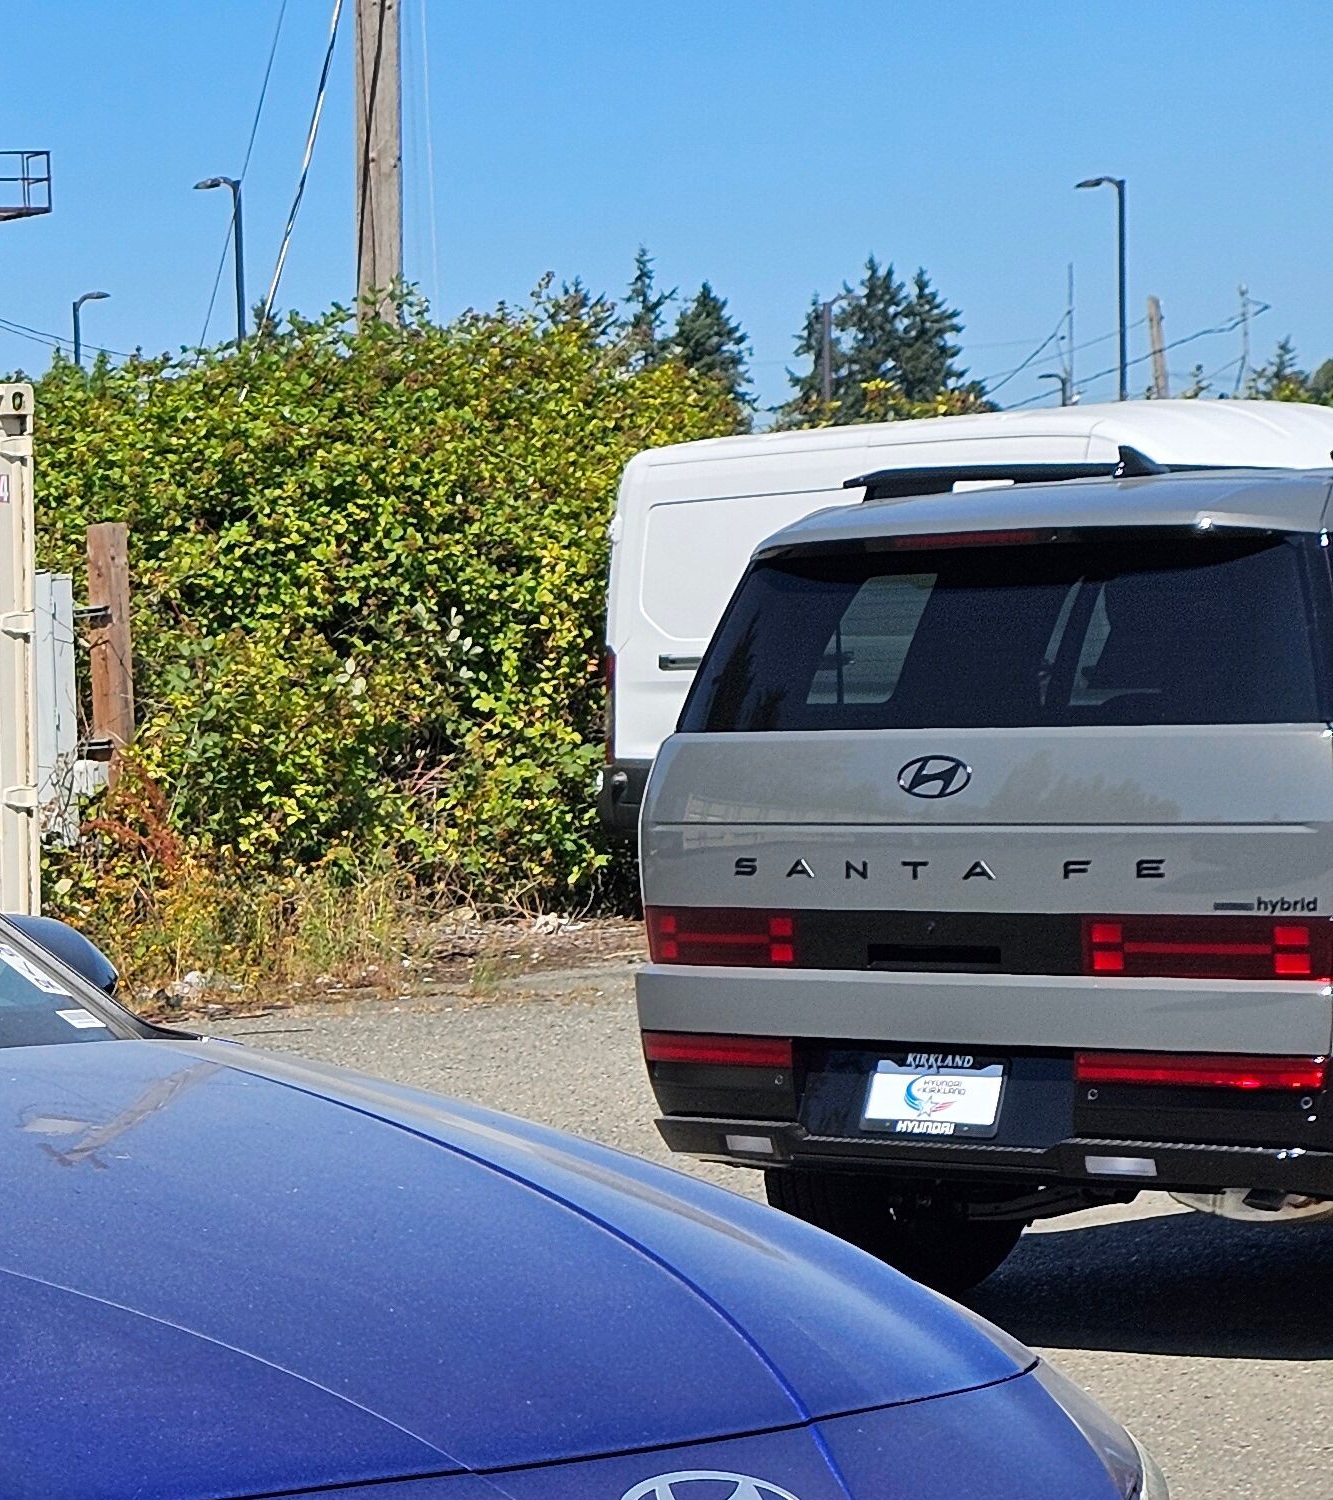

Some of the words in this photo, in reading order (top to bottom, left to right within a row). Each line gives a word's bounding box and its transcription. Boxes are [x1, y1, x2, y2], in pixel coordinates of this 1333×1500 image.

[734, 857, 996, 881] SANTA
[1062, 858, 1167, 881] FE
[1256, 896, 1318, 915] hybrid
[905, 1052, 974, 1074] KIRKLAND
[895, 1120, 956, 1136] HYUNDAI
